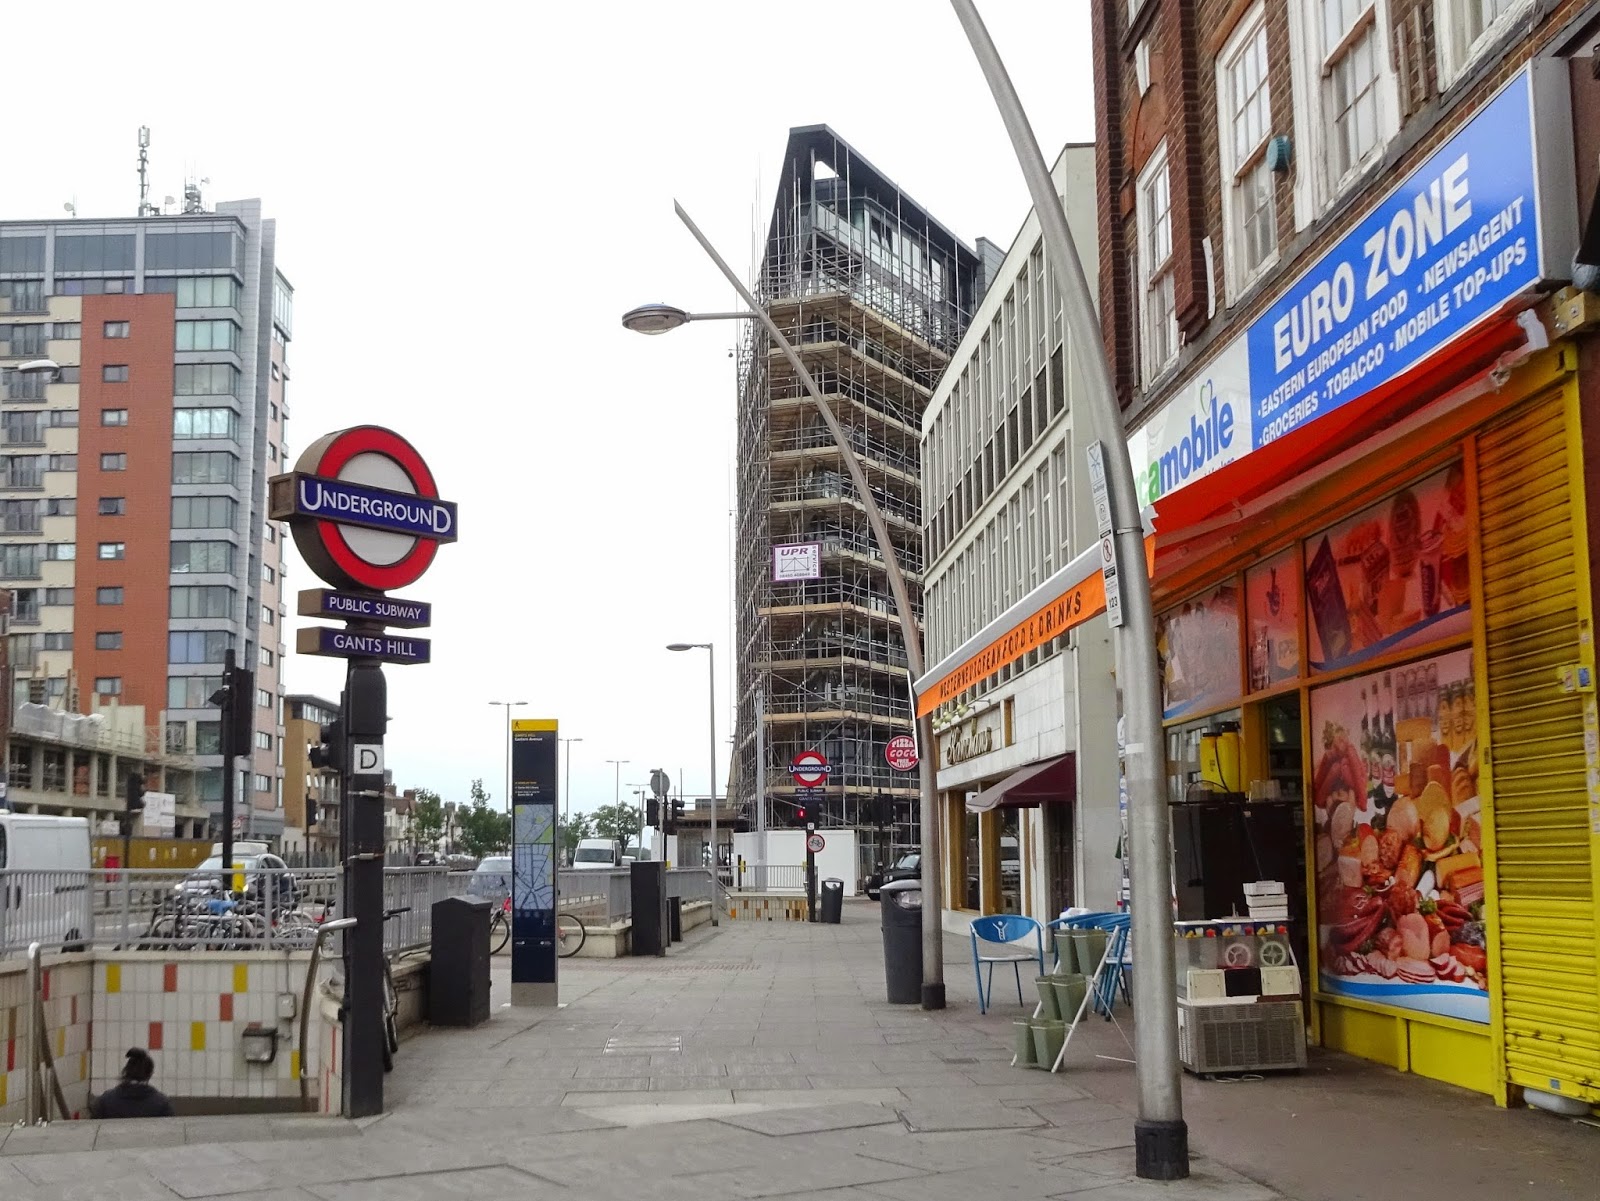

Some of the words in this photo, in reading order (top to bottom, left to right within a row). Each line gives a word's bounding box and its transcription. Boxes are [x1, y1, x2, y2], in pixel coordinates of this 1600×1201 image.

[1274, 261, 1354, 375] EURO
[1364, 152, 1472, 301] ZONE
[1261, 367, 1305, 418] EASTERN
[1307, 318, 1369, 383] EUROPEAN
[1371, 289, 1408, 335] FOOD
[1423, 195, 1524, 294] NEWSAGENT
[1262, 390, 1319, 446] GROCERIES
[1326, 342, 1385, 400] TOBACCO
[1394, 292, 1451, 352] MOBILE
[1453, 236, 1527, 309] TOP-UPS
[300, 480, 451, 533] UNDERGROUND
[780, 548, 809, 556] UPR
[329, 596, 371, 613] PUBLIC
[375, 603, 422, 620] SUBWAY
[1002, 627, 1026, 659] FOOD
[1038, 590, 1082, 637] DRINKS
[333, 634, 382, 653] GANTS
[387, 640, 416, 657] HILL
[890, 749, 916, 758] GOGO
[891, 738, 914, 748] PIZZA
[361, 749, 377, 769] D
[788, 765, 832, 773] UNDERGROUND
